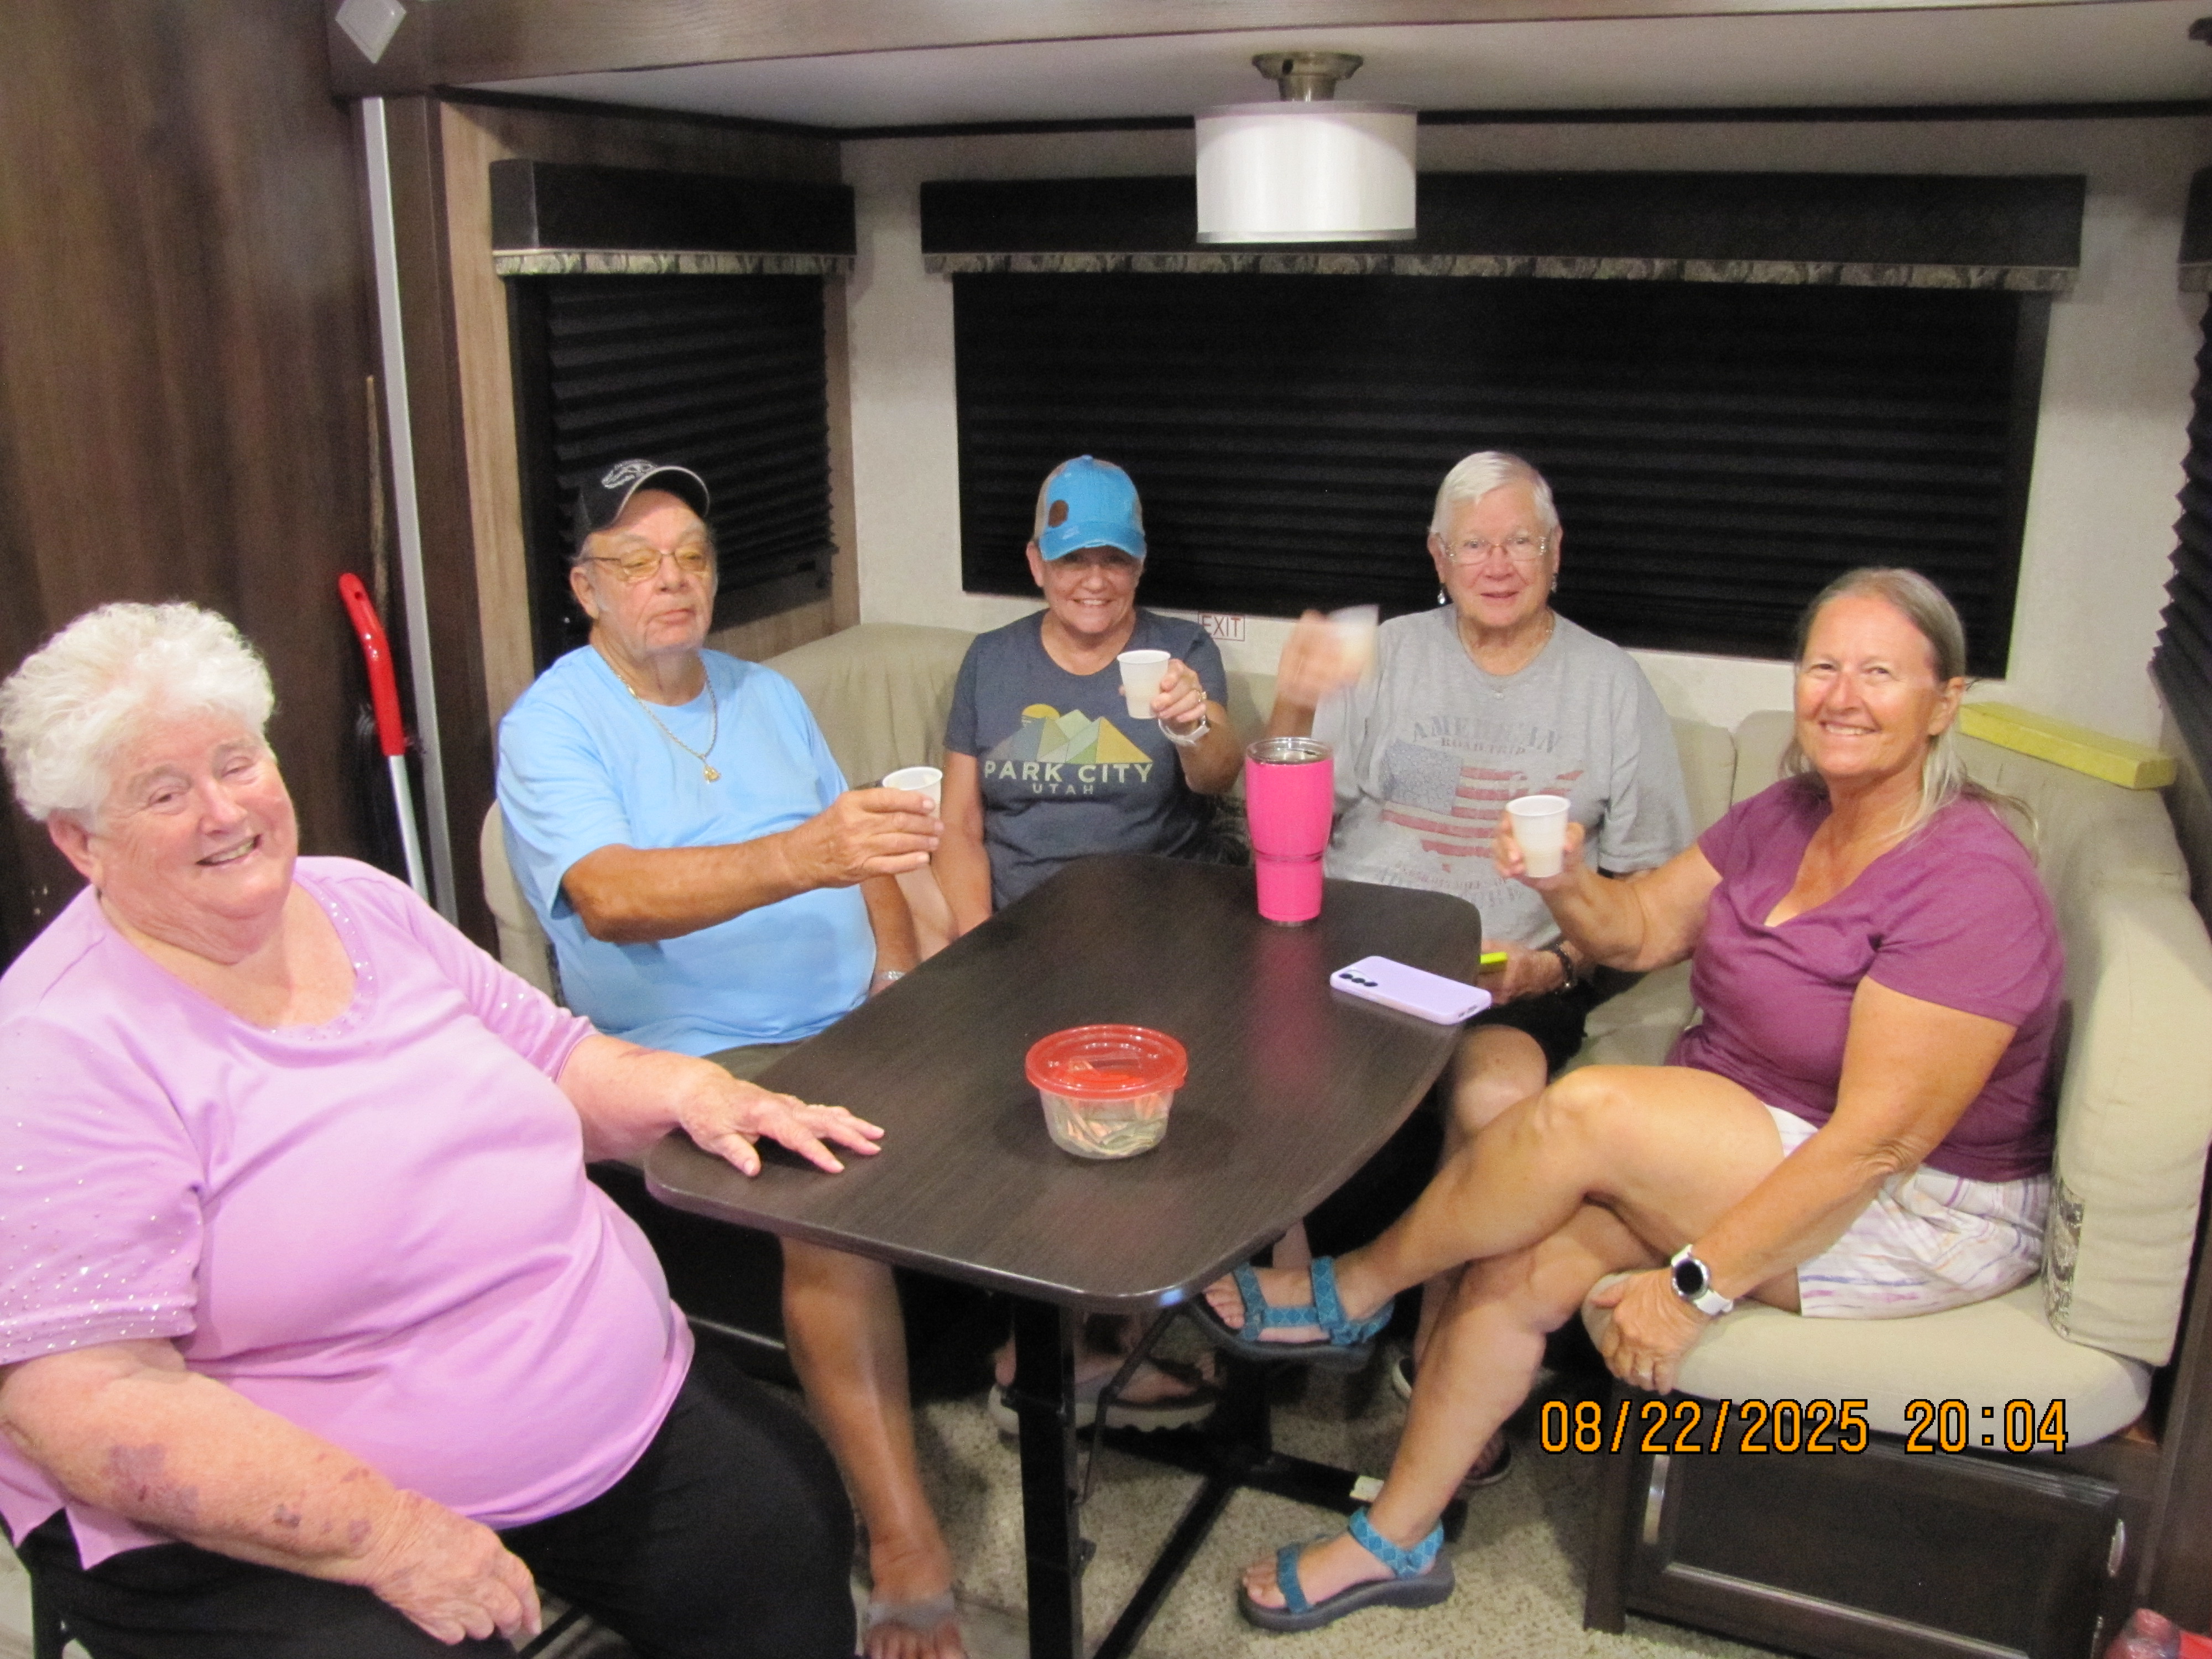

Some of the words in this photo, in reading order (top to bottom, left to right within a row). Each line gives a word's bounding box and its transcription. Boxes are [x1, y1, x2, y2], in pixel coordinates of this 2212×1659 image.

[1202, 614, 1241, 638] EXIT
[984, 760, 1063, 782] PARK
[1078, 763, 1153, 783] CITY
[1032, 783, 1094, 795] UTAH
